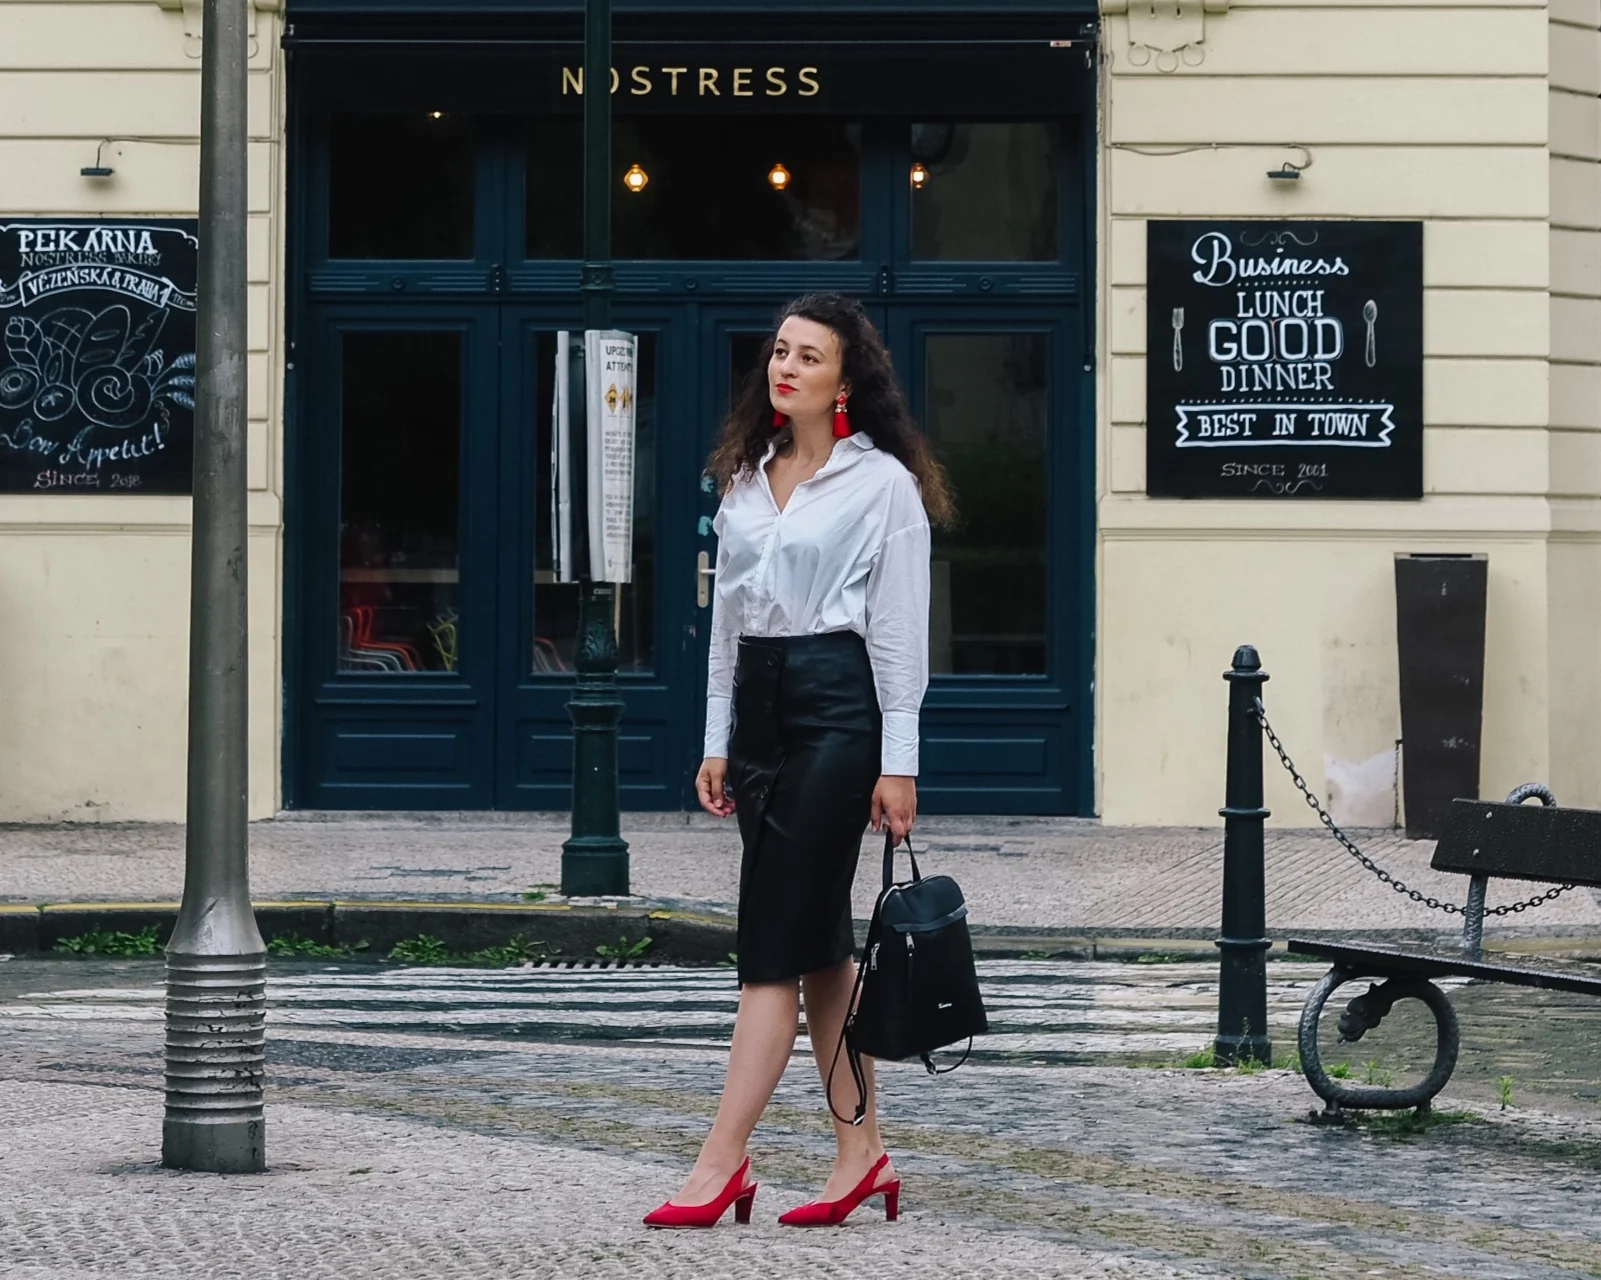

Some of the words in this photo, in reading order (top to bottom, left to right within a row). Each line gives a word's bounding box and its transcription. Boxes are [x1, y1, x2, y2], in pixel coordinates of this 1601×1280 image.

[20, 252, 108, 268] NOSTRESS
[1191, 232, 1350, 287] Business
[1237, 290, 1325, 318] LUNCH
[1209, 318, 1344, 361] GOOD
[1220, 362, 1335, 392] DINNER
[1197, 413, 1257, 437] BEST
[1272, 413, 1298, 436] IN
[1308, 413, 1371, 437] TOWN
[1220, 462, 1286, 477] SINCE
